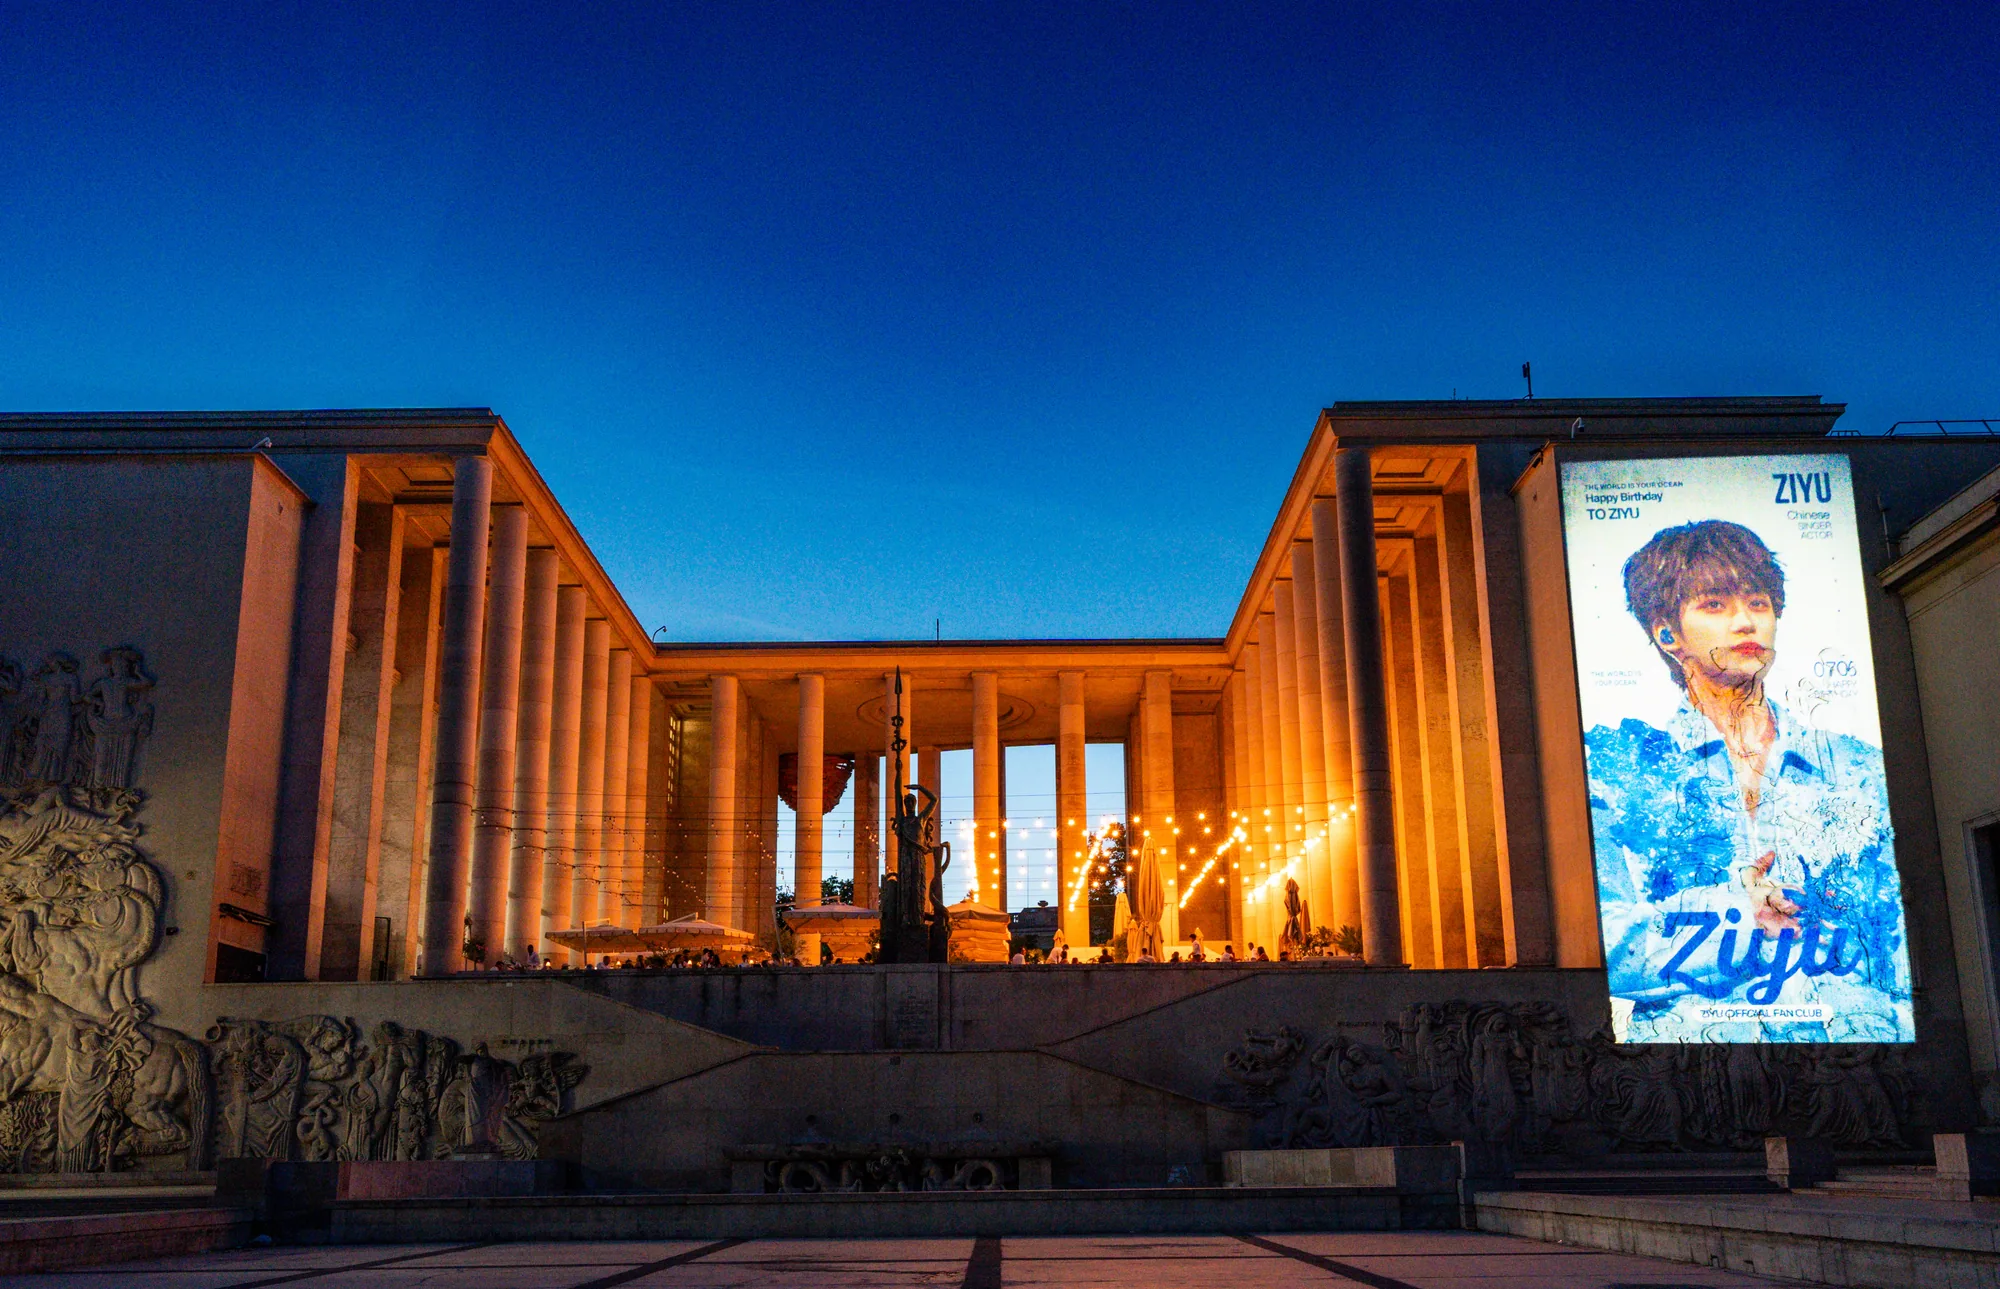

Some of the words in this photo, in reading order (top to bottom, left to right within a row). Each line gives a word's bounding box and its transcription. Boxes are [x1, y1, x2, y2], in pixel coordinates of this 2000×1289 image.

[1584, 483, 1599, 491] THE
[1772, 472, 1832, 504] ZIYU
[1585, 493, 1618, 504] Happy
[1620, 492, 1663, 502] Birthday
[1586, 508, 1606, 520] TO
[1608, 507, 1640, 520] ZIYU
[1787, 510, 1830, 520] Chinese
[1801, 531, 1832, 539] ACTOR
[1659, 908, 1862, 1005] Ziyu
[1773, 1009, 1794, 1018] FAN
[1795, 1009, 1823, 1018] CLUB
